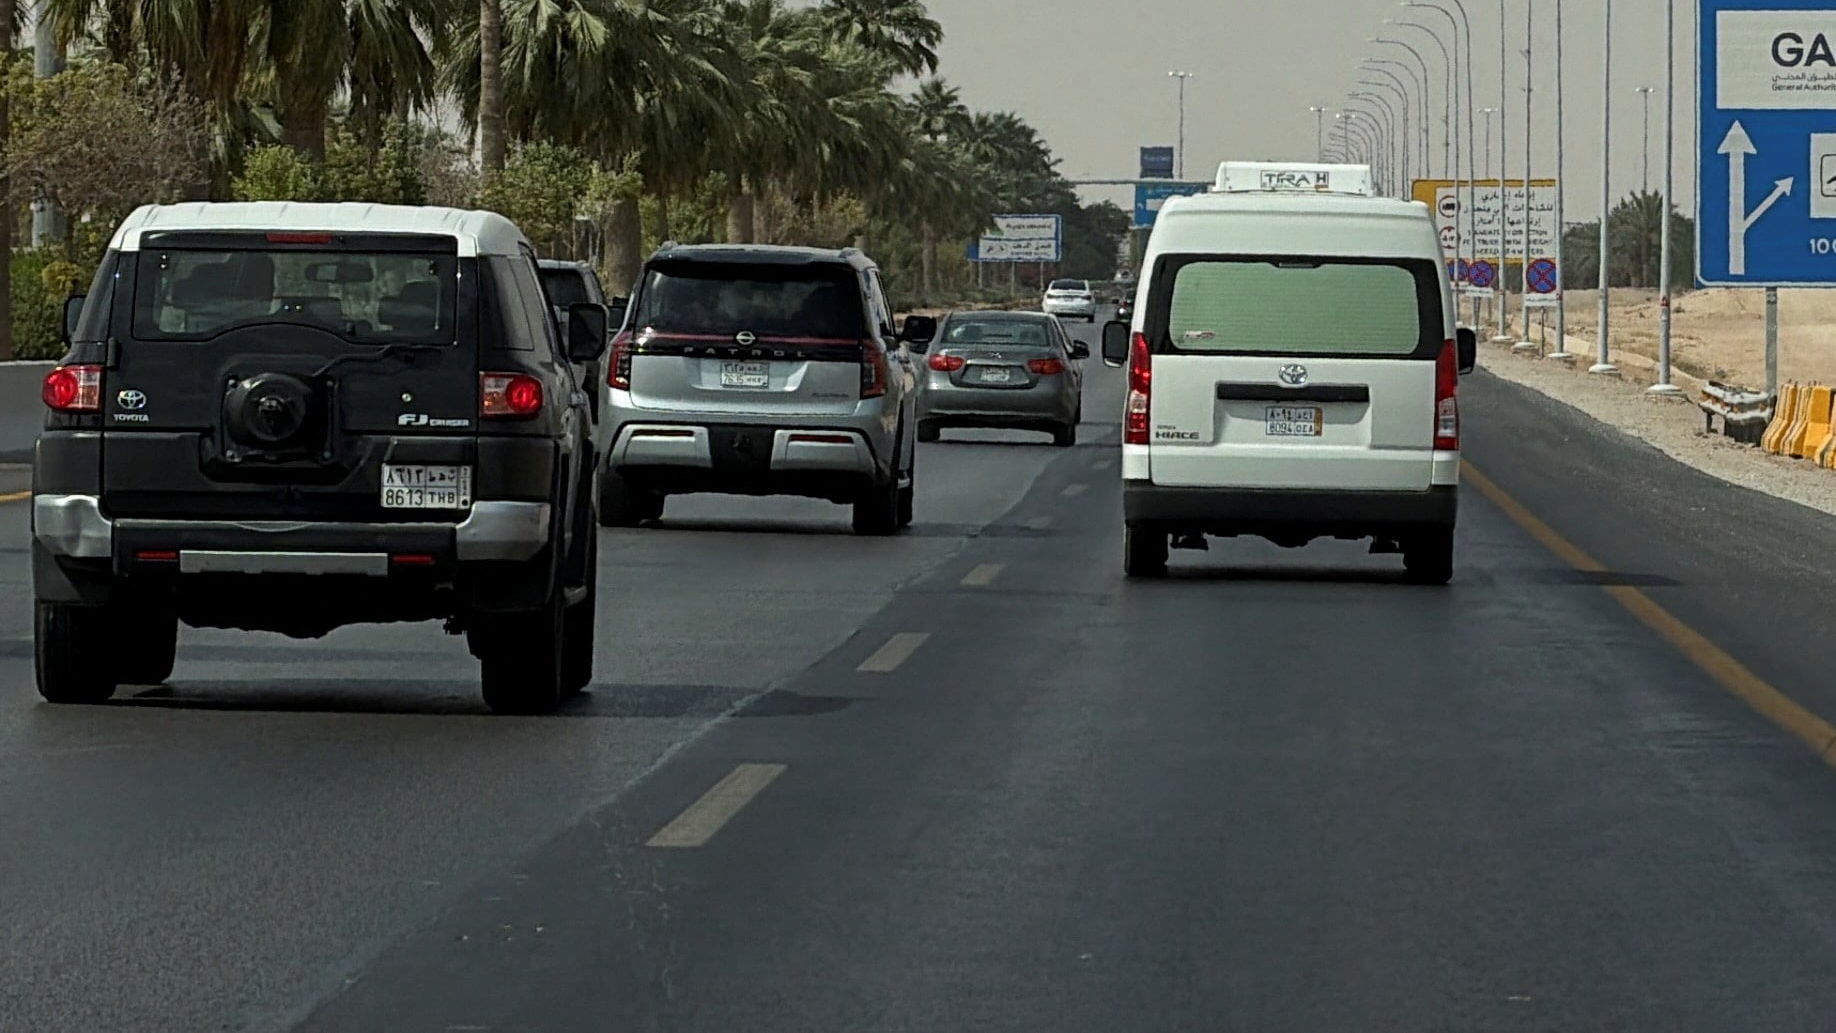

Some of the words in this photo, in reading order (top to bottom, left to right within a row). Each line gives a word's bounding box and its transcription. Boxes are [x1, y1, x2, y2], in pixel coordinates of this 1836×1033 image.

[683, 346, 806, 359] PATROL
[113, 413, 150, 422] TOYOTA
[398, 413, 429, 426] FJ
[1155, 431, 1200, 440] HIACE
[385, 488, 424, 506] 8613
[428, 491, 456, 504] THB
